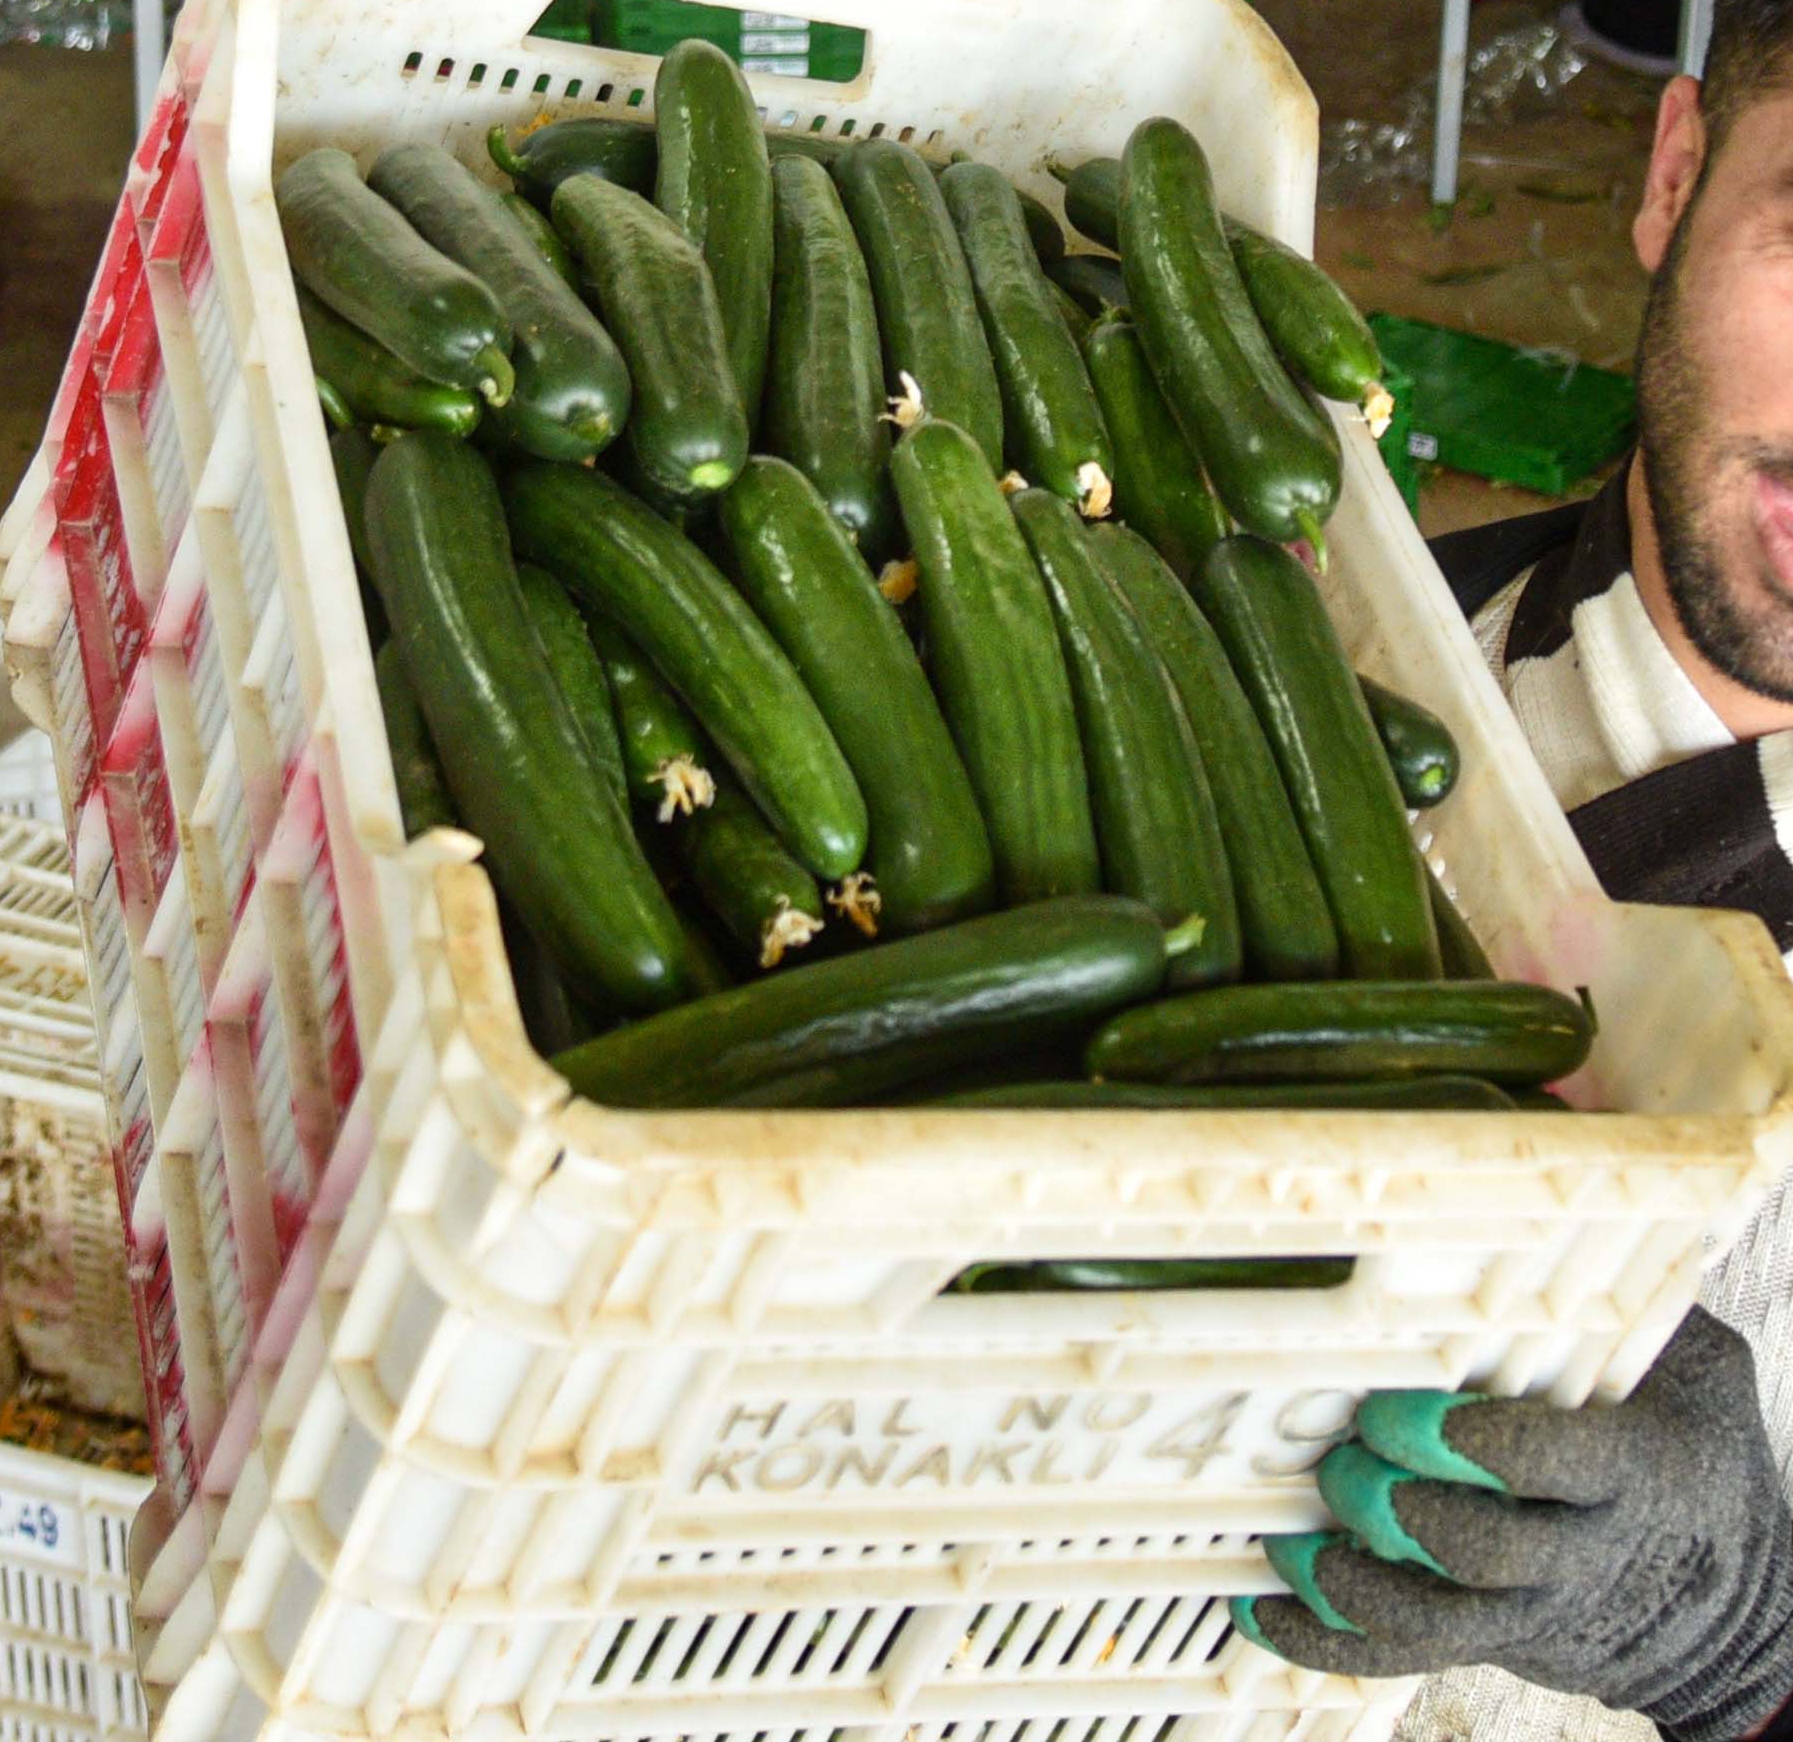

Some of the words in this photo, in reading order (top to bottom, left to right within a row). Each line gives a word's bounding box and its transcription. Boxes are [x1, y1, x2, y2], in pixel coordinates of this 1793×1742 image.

[717, 1391, 927, 1442] HAL
[996, 1390, 1152, 1434] NO
[691, 1437, 1122, 1495] KONAKLI
